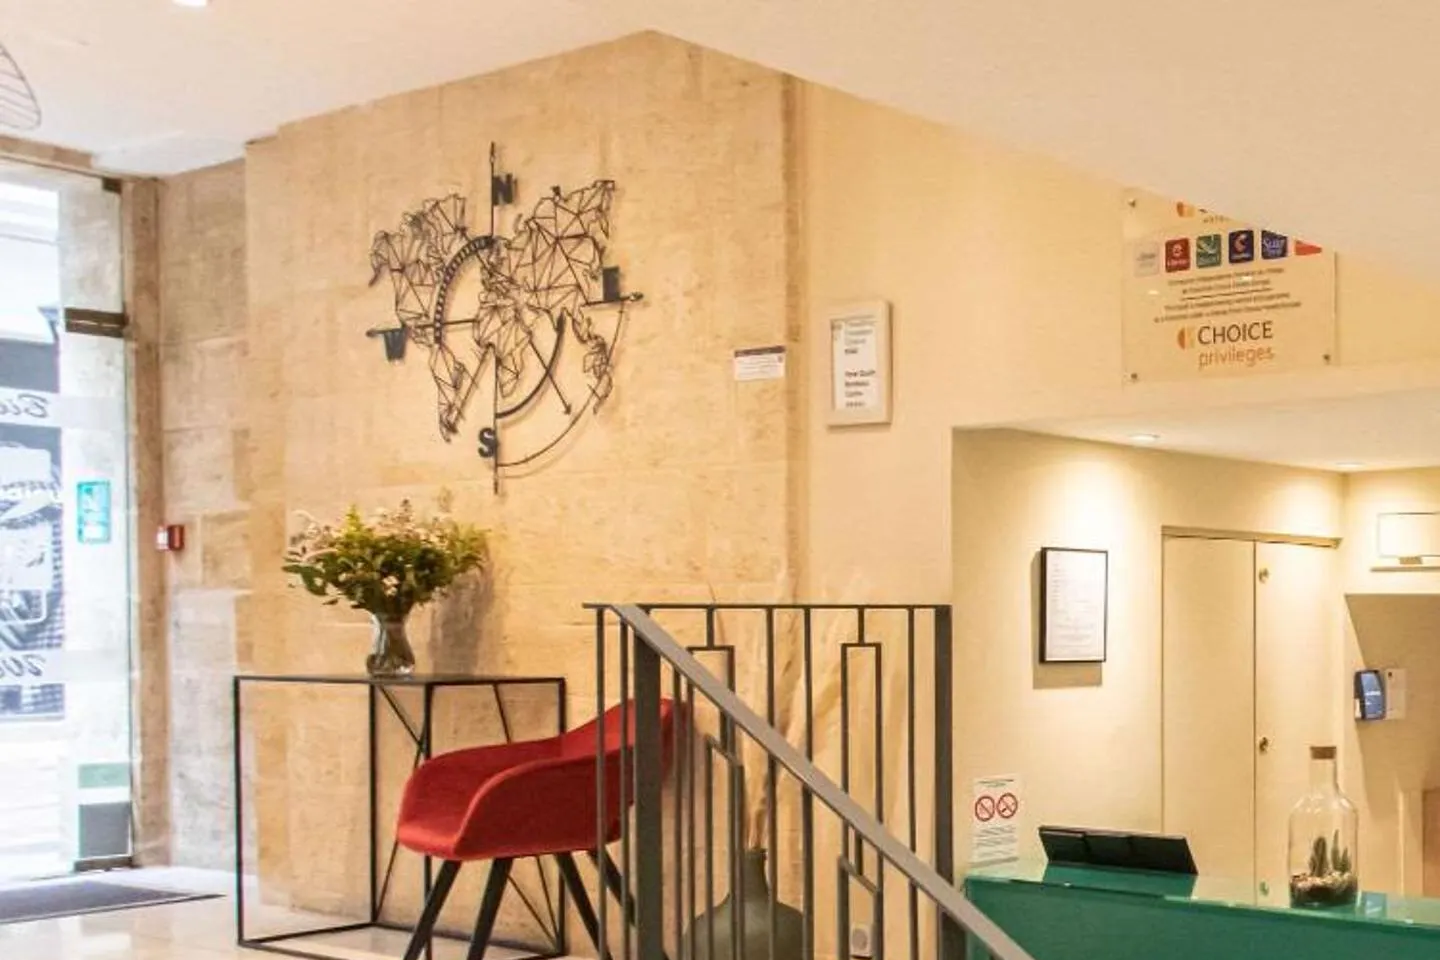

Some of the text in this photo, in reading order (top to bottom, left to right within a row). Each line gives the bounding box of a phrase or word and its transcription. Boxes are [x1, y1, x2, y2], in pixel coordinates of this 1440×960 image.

[493, 173, 514, 205] N
[1197, 320, 1274, 345] CHOICE
[1198, 345, 1275, 372] privileges
[477, 427, 498, 459] S
